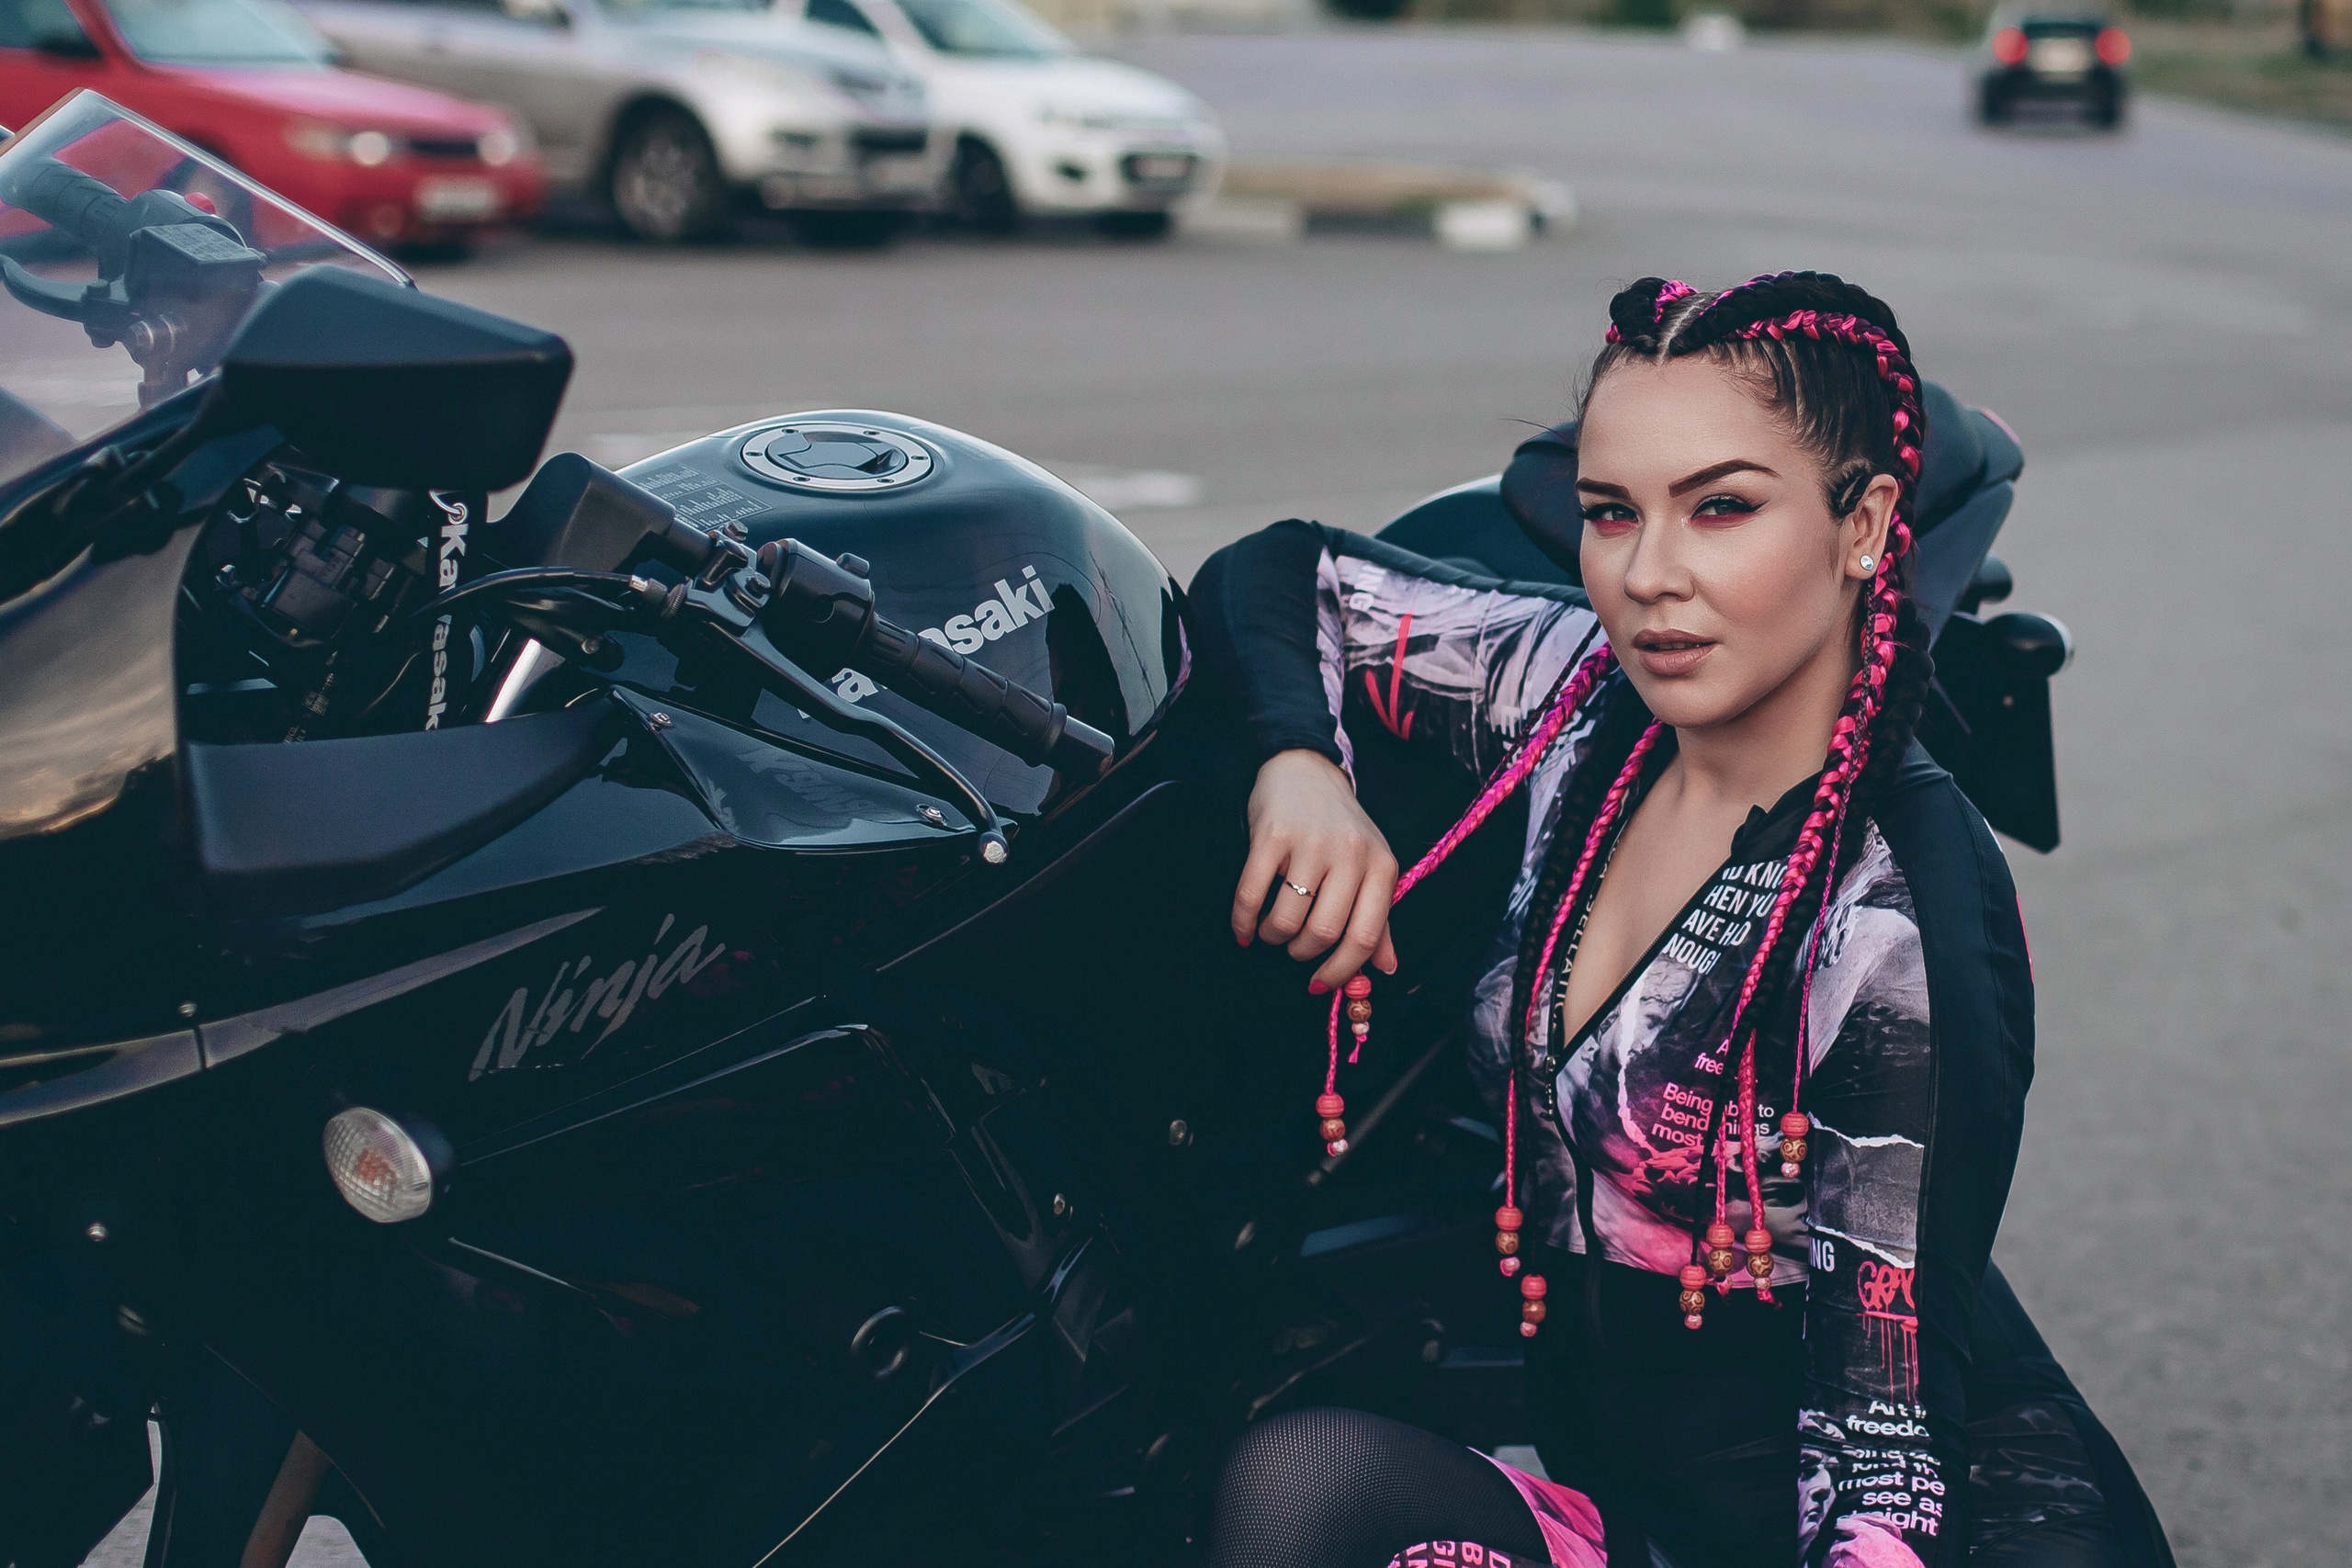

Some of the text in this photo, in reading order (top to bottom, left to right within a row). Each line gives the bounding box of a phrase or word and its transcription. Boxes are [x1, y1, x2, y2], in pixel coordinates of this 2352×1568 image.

[425, 523, 469, 732] Kaasak
[468, 913, 726, 1082] Ninja
[1663, 1082, 1713, 1117] Being
[1758, 1104, 1775, 1118] to
[1660, 1102, 1711, 1132] bend
[1651, 1122, 1704, 1147] most
[1838, 1471, 1905, 1492] most
[1861, 1491, 1912, 1506] see
